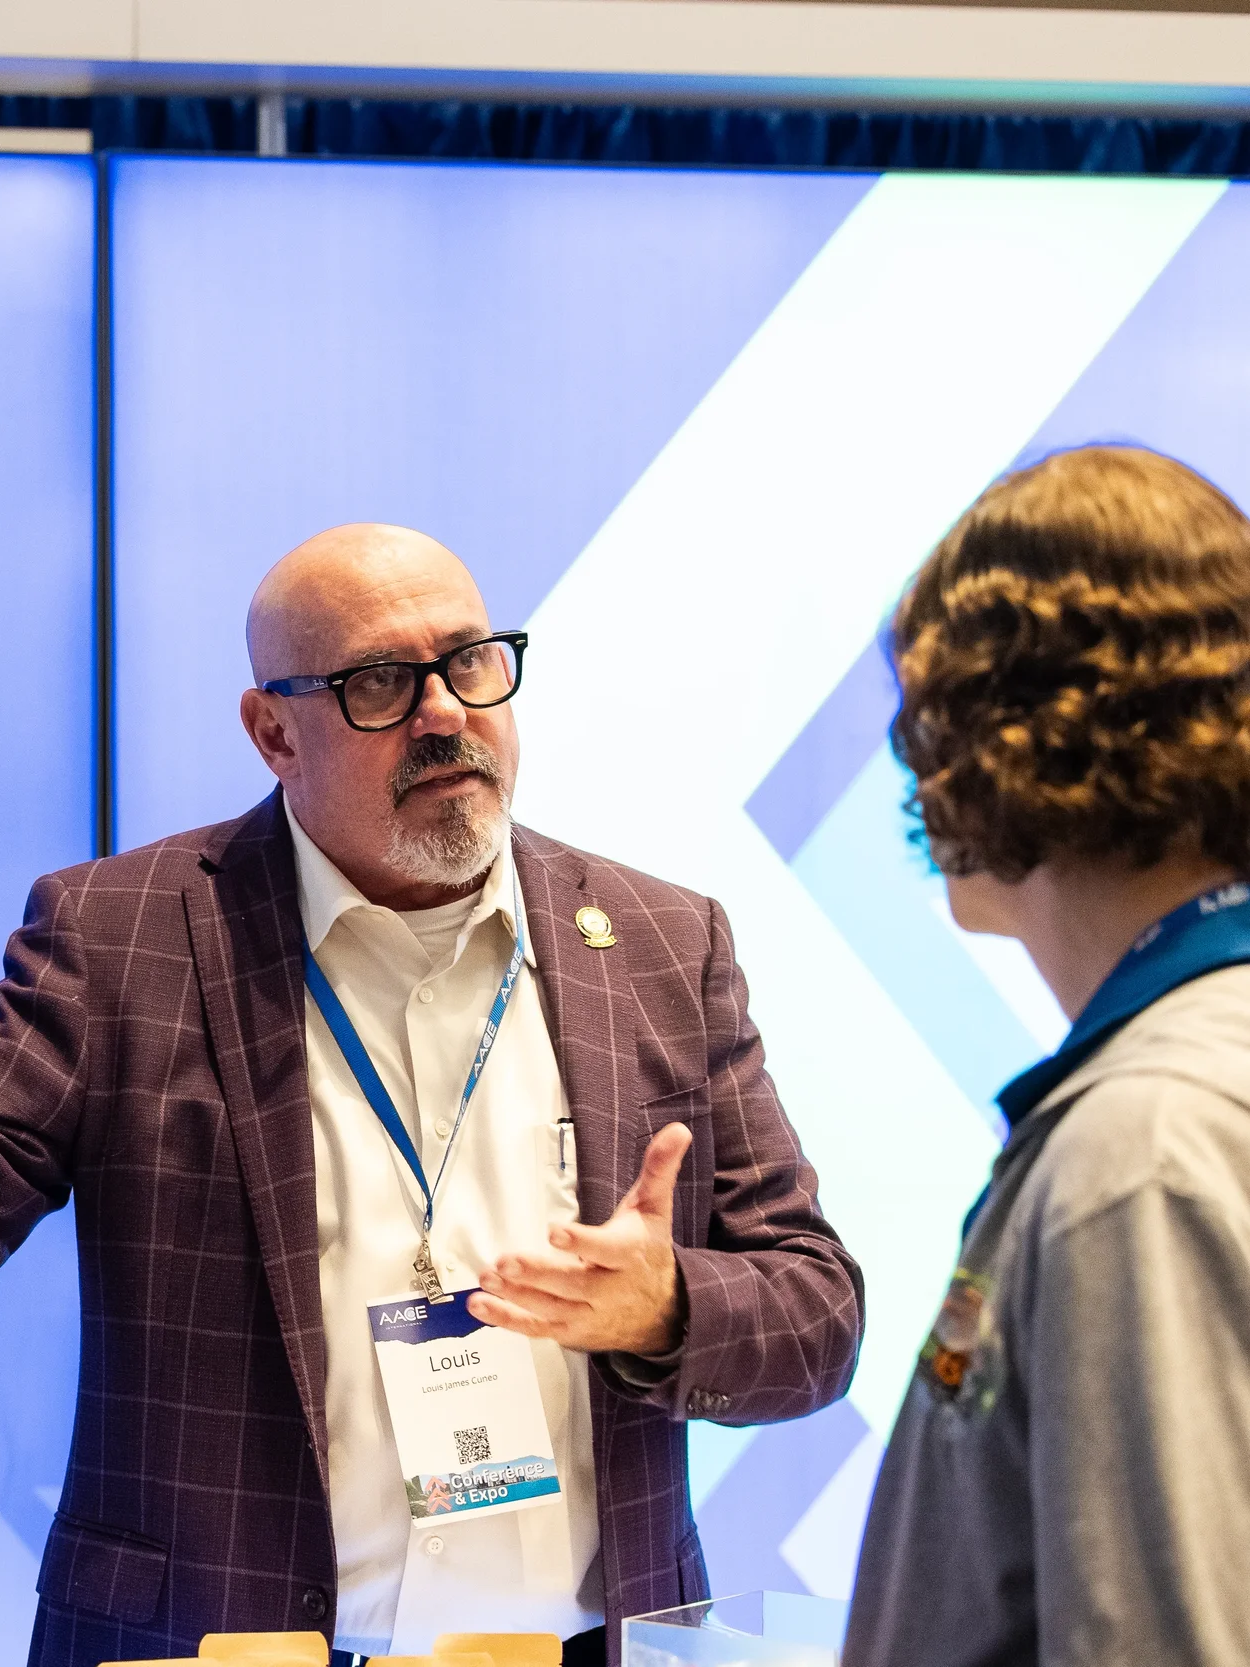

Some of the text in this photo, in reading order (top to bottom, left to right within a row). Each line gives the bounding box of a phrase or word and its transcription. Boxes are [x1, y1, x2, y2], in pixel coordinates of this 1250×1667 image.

[500, 946, 524, 1004] AACE
[473, 1020, 498, 1079] AACE
[379, 1305, 428, 1326] AACE
[429, 1349, 481, 1372] Louis
[421, 1374, 498, 1394] Louis James Cuneo
[451, 1462, 545, 1489] Conference
[454, 1486, 508, 1505] & Expo
